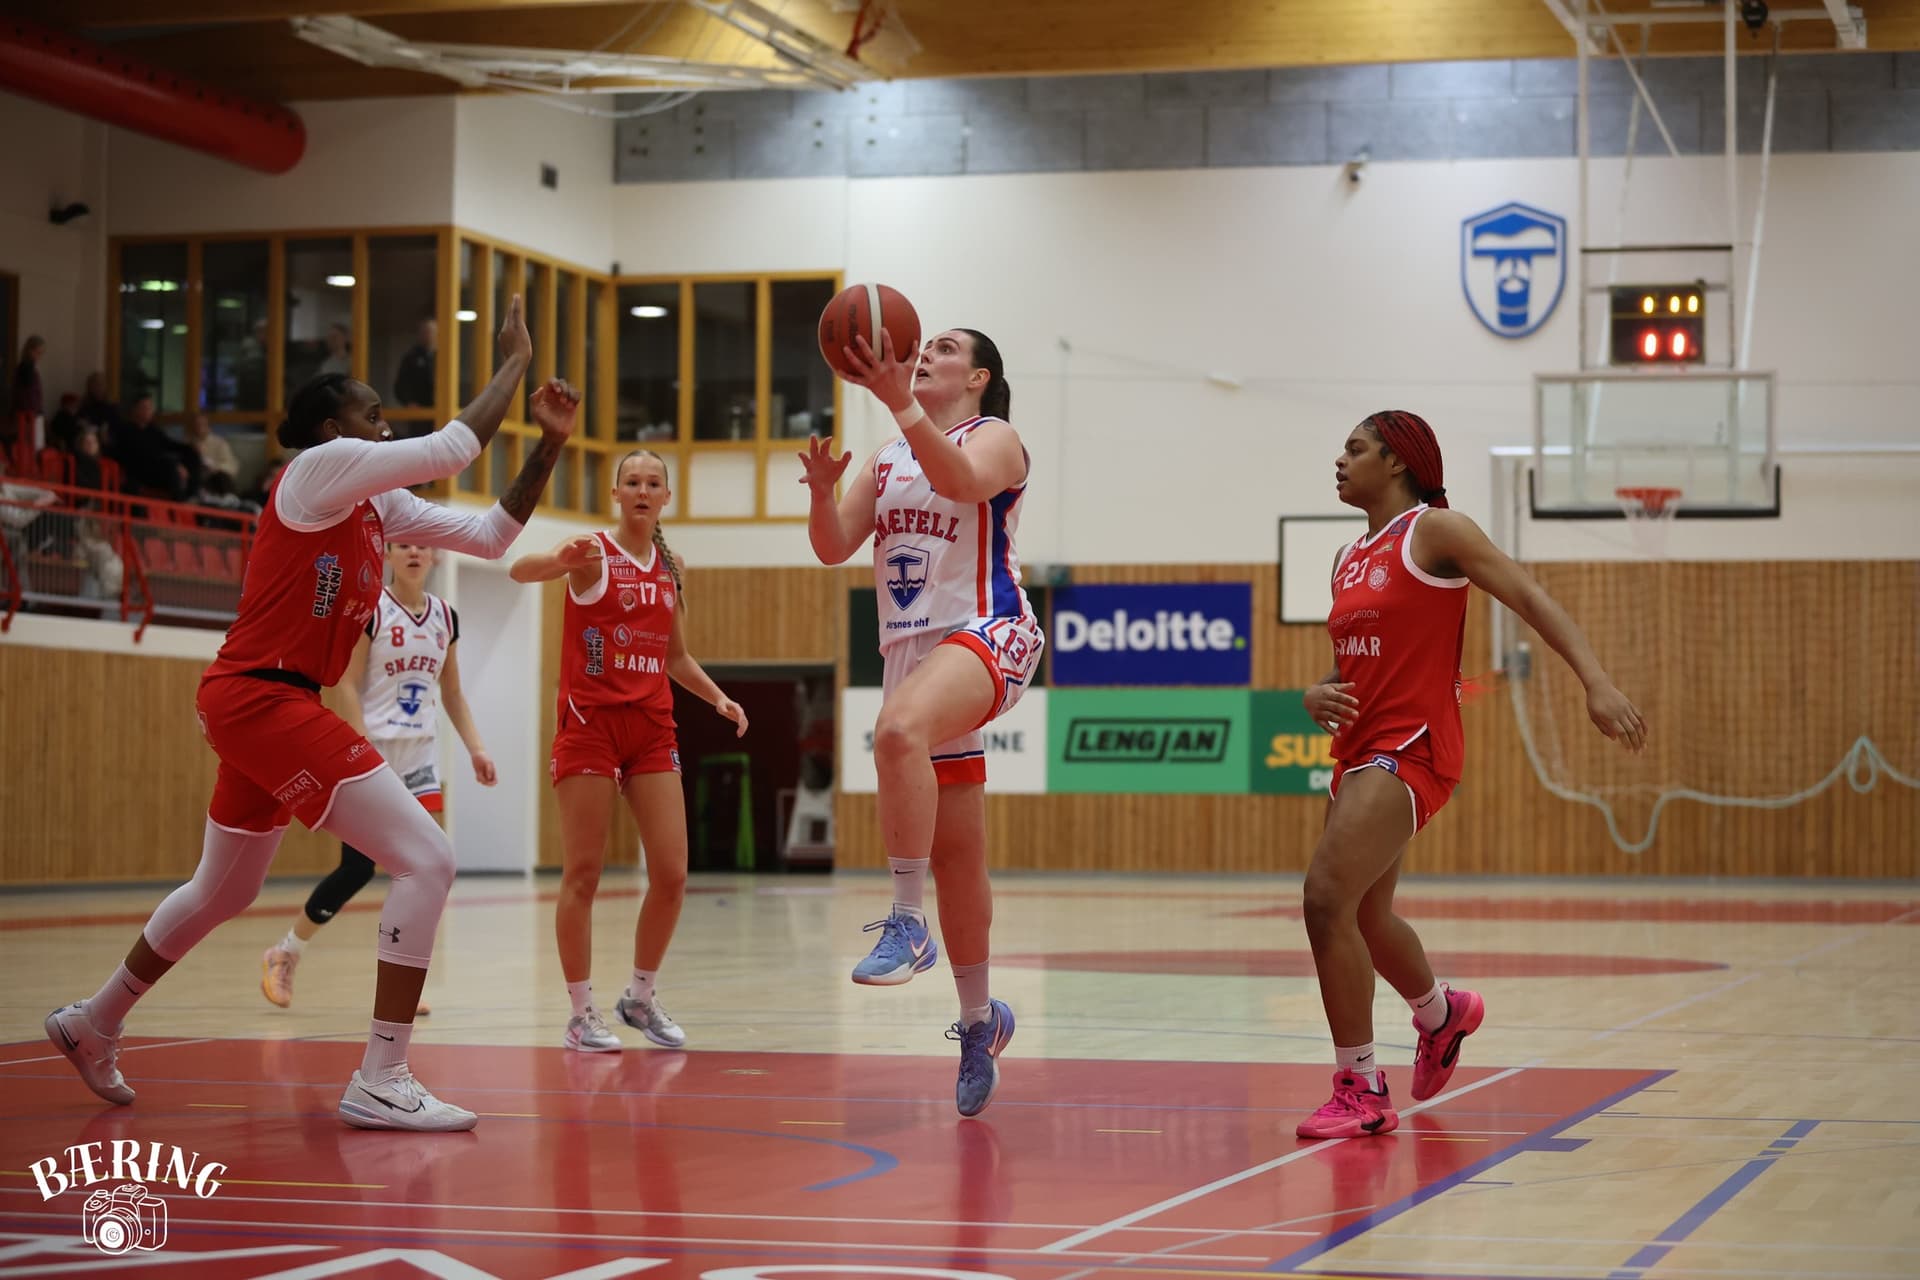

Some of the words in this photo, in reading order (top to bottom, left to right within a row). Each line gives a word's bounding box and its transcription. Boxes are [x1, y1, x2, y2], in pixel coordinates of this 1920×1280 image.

[1343, 557, 1371, 590] 23
[640, 581, 657, 605] 17
[914, 617, 930, 628] ehf
[391, 626, 405, 648] 8
[1003, 628, 1028, 666] 13
[385, 655, 438, 677] SNÆFE
[628, 654, 665, 674] ARM
